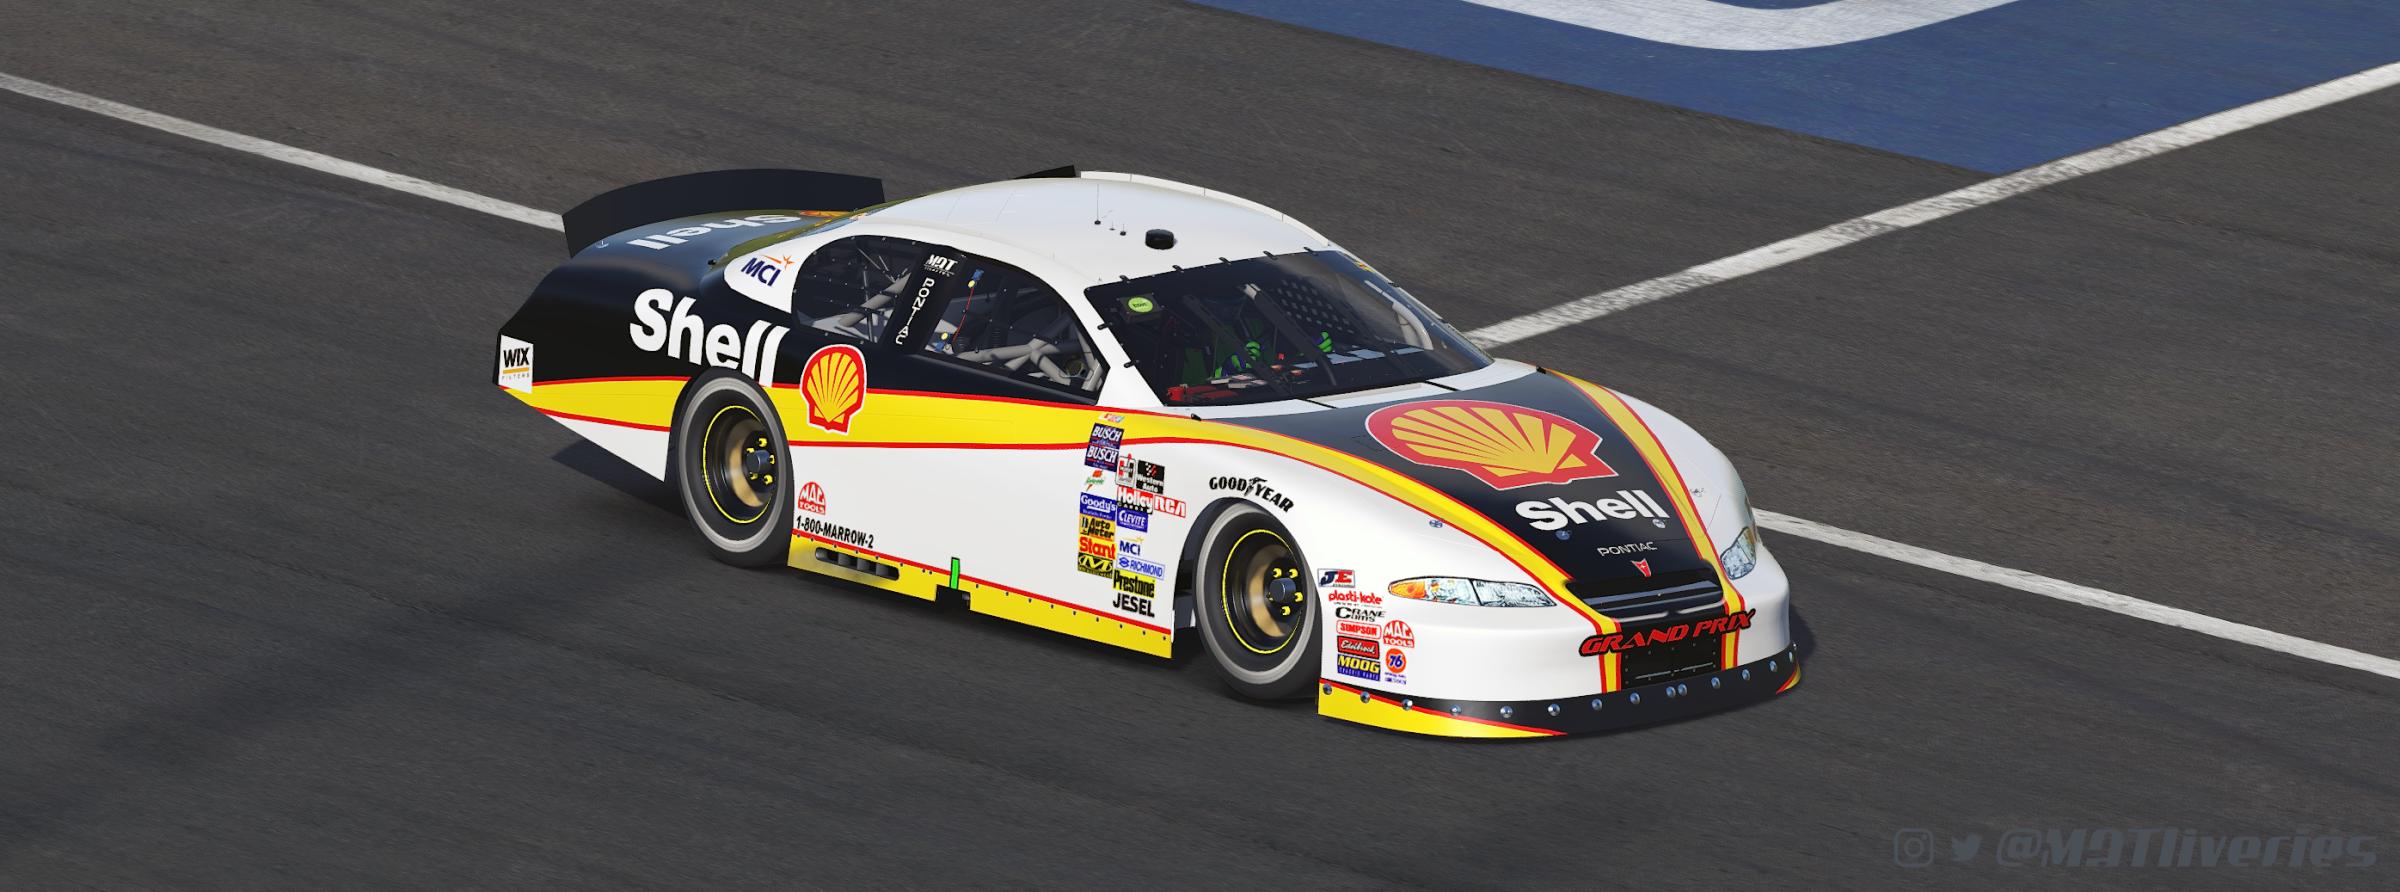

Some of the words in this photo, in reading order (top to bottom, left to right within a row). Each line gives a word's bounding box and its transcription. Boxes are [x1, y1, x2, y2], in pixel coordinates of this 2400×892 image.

[627, 215, 800, 250] Shell
[741, 258, 781, 287] MCI
[895, 277, 935, 345] PONTIAC
[630, 288, 790, 388] Shell
[503, 347, 530, 368] WIX
[1092, 425, 1122, 442] BUSCH
[1086, 445, 1118, 463] BUSCH
[1136, 473, 1164, 487] Western
[799, 501, 825, 514] TOOLS
[1080, 494, 1116, 513] Goody's
[1117, 486, 1154, 514] Holley
[1154, 495, 1186, 518] RCA
[1119, 510, 1147, 526] CLEVITE
[1515, 489, 1671, 531] Shell
[796, 515, 874, 549] 1-800-MARROW-2
[1090, 518, 1111, 529] Auto
[1080, 537, 1116, 560] Stant
[1119, 540, 1141, 556] MCI
[1597, 541, 1658, 557] PONTIAC
[1129, 560, 1163, 577] RICHMOND
[1113, 569, 1155, 598] Prestone
[1320, 570, 1353, 586] JE
[1112, 592, 1155, 618] JESEL
[1328, 590, 1382, 605] plasti-kote
[1340, 622, 1378, 636] SIMPSON
[1580, 625, 1690, 655] GRAND
[1692, 610, 1755, 638] PRIX
[1384, 637, 1414, 647] TOOLS
[1338, 655, 1380, 673] MOOG
[1389, 654, 1403, 667] 76
